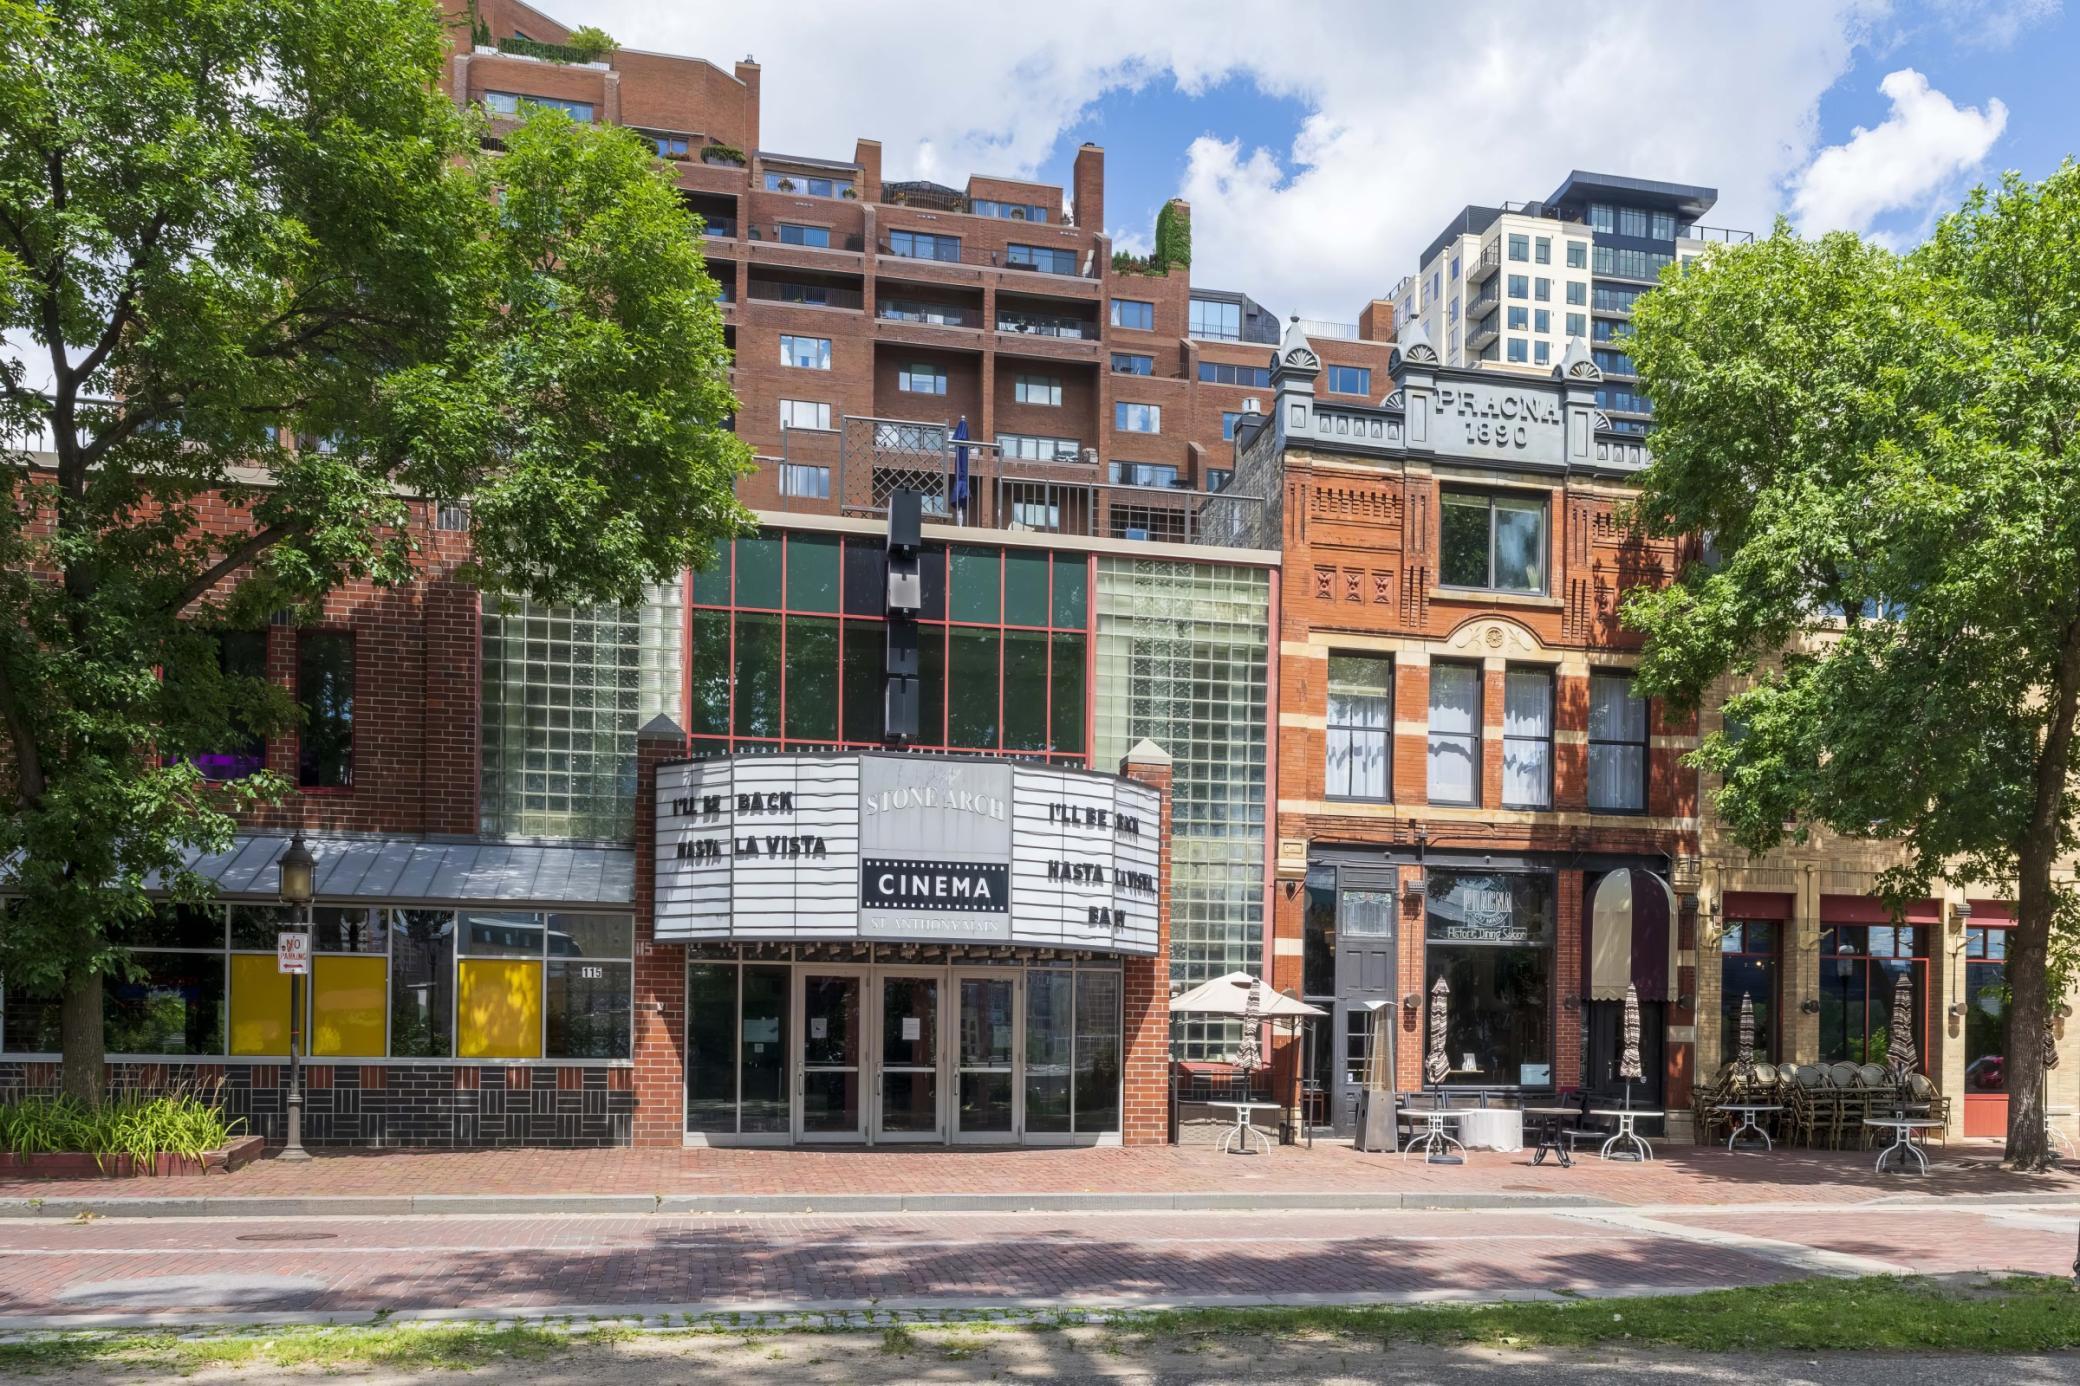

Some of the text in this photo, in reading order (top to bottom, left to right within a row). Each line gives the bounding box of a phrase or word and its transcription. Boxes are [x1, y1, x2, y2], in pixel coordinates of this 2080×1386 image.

[1436, 389, 1559, 425] PRACNA
[1465, 421, 1528, 449] 1890
[737, 790, 794, 811] BACK
[866, 786, 1005, 822] STONE ARCH
[1049, 802, 1081, 824] I'LL
[1085, 806, 1107, 828] BE
[677, 834, 827, 859] HASTA LA VISTA
[1047, 859, 1104, 883] HASTA
[878, 873, 991, 898] CINEMA
[286, 938, 301, 950] NO
[582, 967, 602, 978] 115
